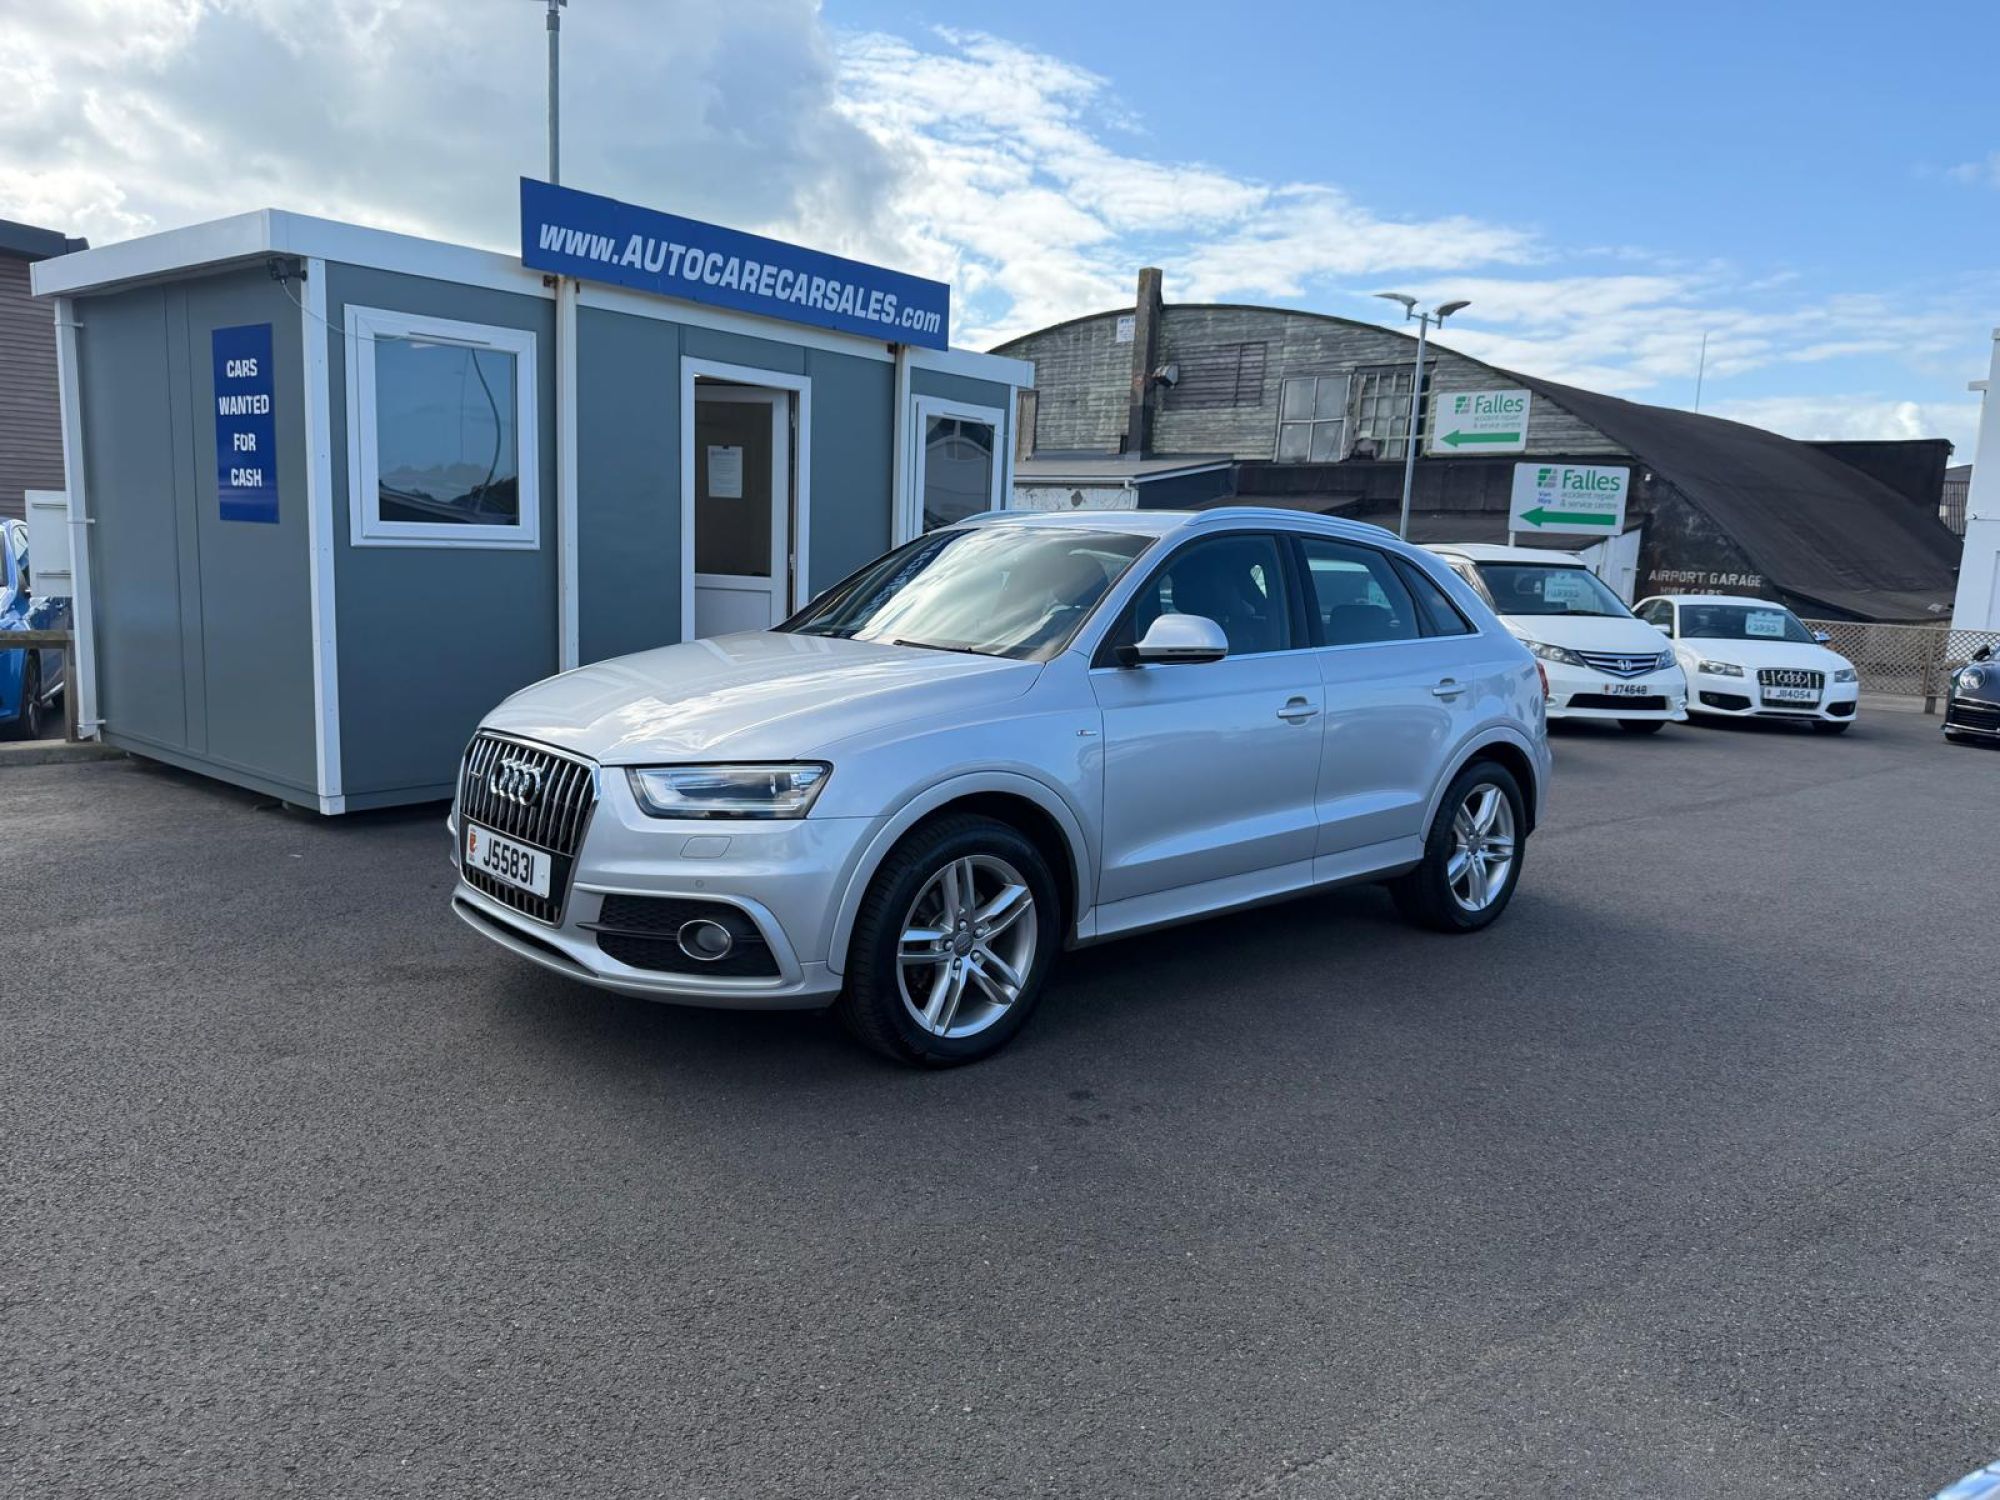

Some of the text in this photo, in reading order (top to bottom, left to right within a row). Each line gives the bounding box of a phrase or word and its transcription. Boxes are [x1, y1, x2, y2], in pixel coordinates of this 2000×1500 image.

[226, 358, 258, 378] CARS
[219, 394, 270, 416] WANTED
[1474, 394, 1524, 414] Falles
[233, 433, 256, 452] FOR
[231, 468, 262, 488] CASH
[1562, 469, 1621, 491] Falles
[1648, 569, 1762, 588] AIRPORT GARAGE
[483, 837, 535, 886] J55831
